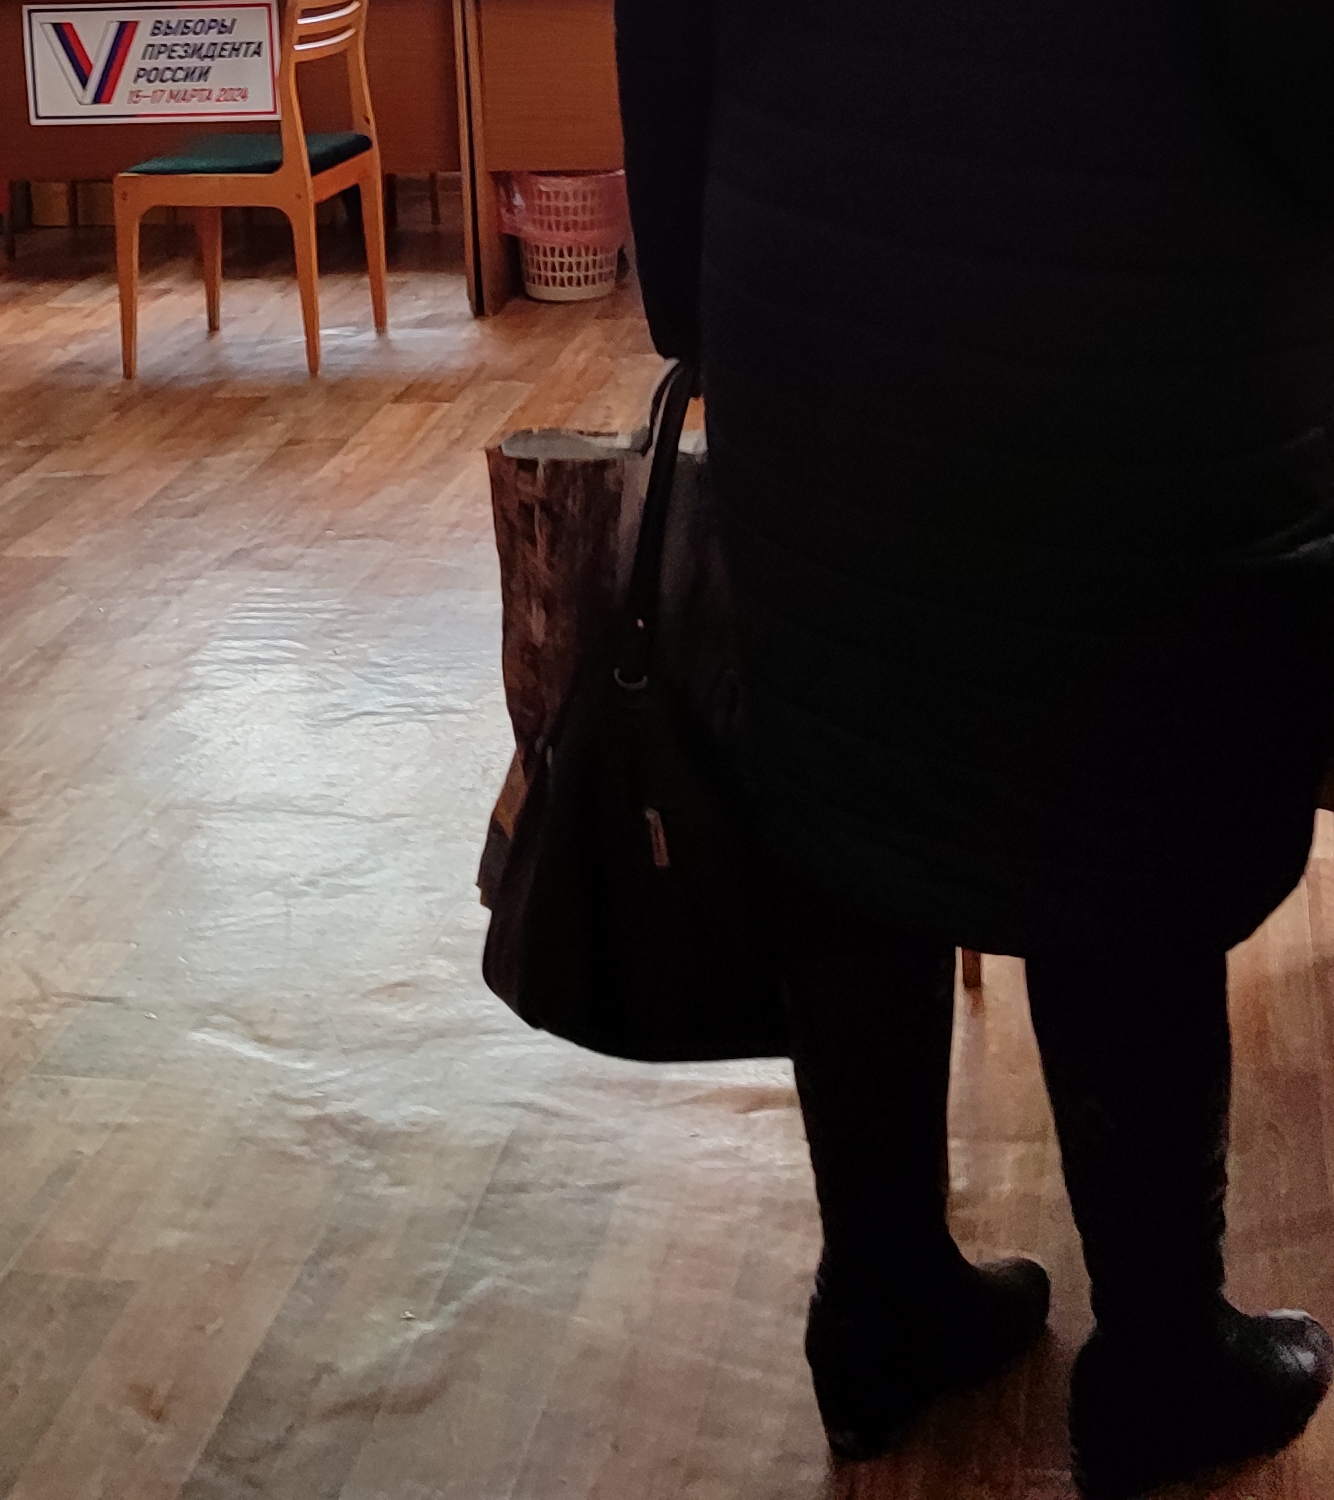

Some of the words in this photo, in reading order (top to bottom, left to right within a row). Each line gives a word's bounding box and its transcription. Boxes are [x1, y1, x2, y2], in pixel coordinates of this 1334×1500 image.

[149, 18, 238, 37] ВЫБОРЫ
[140, 41, 264, 61] ПРЕЗИДЕНТА
[133, 65, 212, 84] РОССИИ
